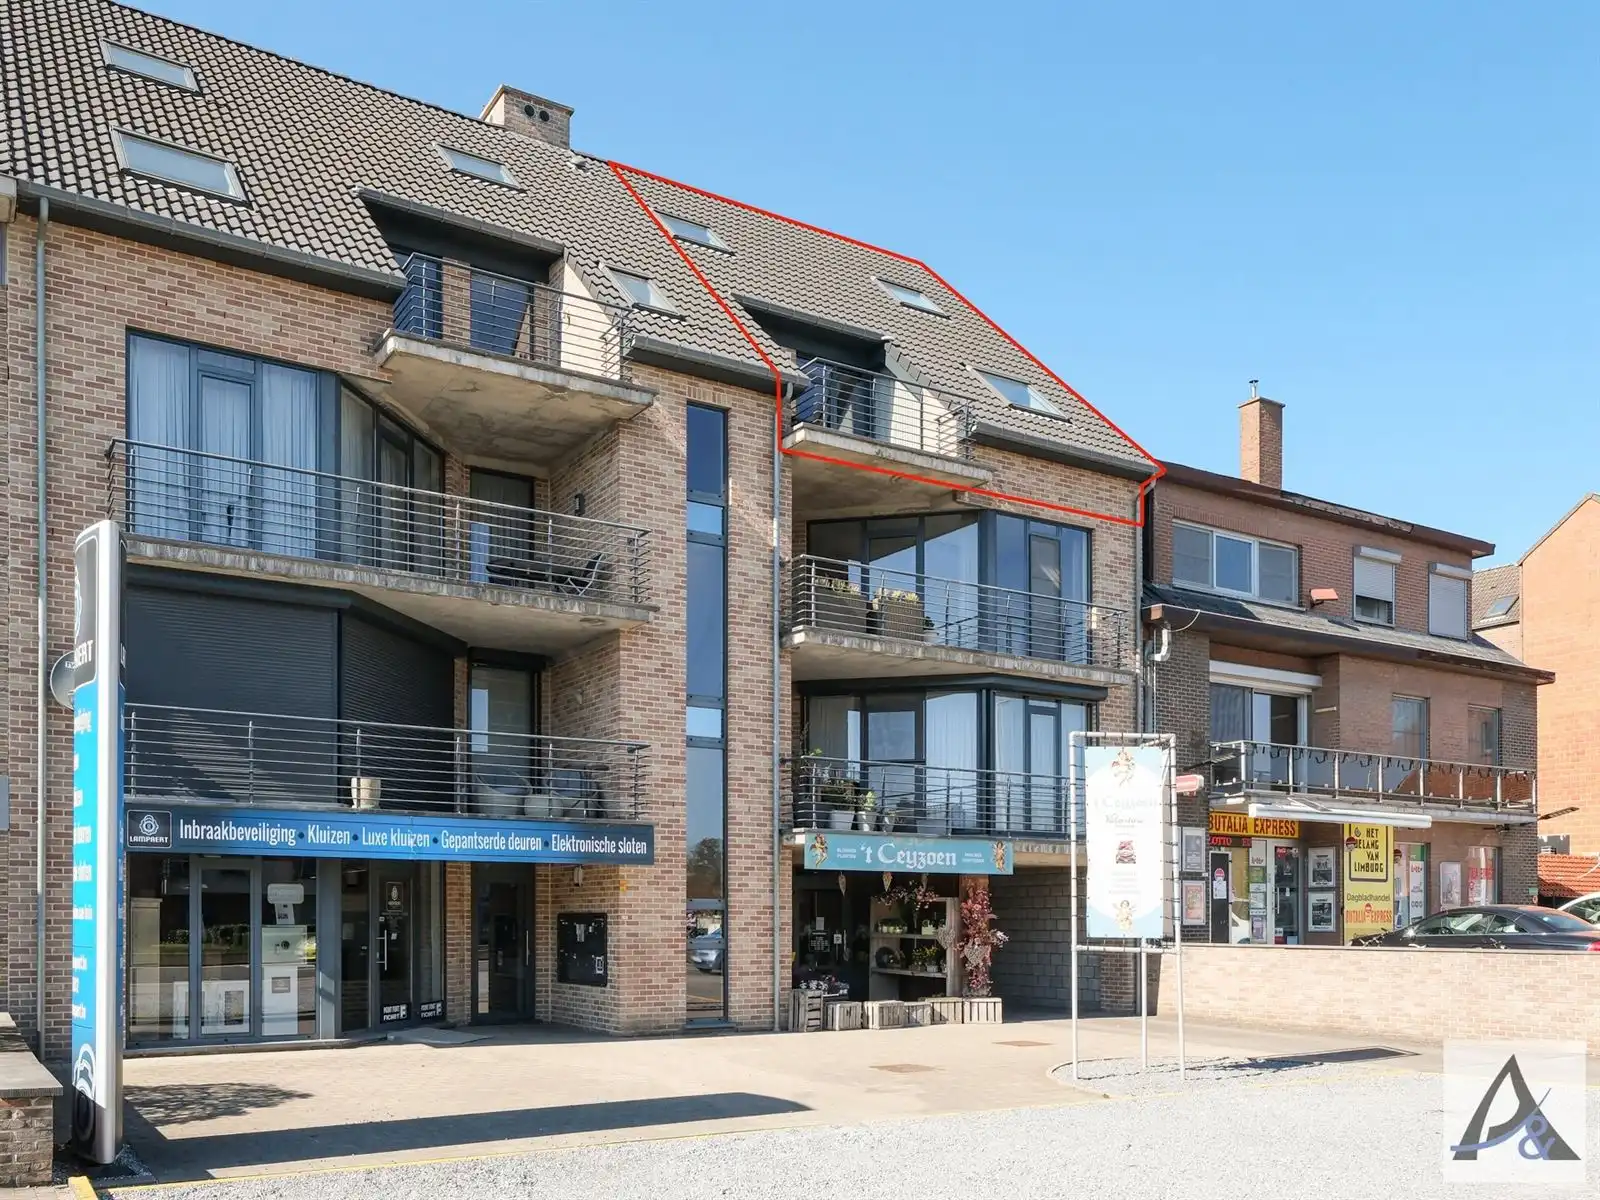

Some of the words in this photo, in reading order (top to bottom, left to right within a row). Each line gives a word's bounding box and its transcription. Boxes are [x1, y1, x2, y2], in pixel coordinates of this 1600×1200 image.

[1208, 814, 1249, 834] BUTALIA
[1253, 817, 1296, 837] EXPRESS
[179, 818, 297, 847] Inbraakbeveiliging
[307, 824, 351, 845] Kluizen
[362, 826, 388, 847] Luxe
[390, 828, 430, 848] kluizen
[441, 829, 506, 853] Gepantserde
[508, 832, 542, 852] deuren
[551, 833, 617, 854] Elektronische
[617, 836, 647, 855] sloten
[1366, 828, 1379, 838] HET
[1354, 839, 1379, 849] ELANG
[877, 843, 957, 869] Ceyzoen
[1366, 851, 1379, 861] VAN
[1354, 862, 1384, 873] LIMBURG
[1346, 893, 1391, 902] Dagbladhandel
